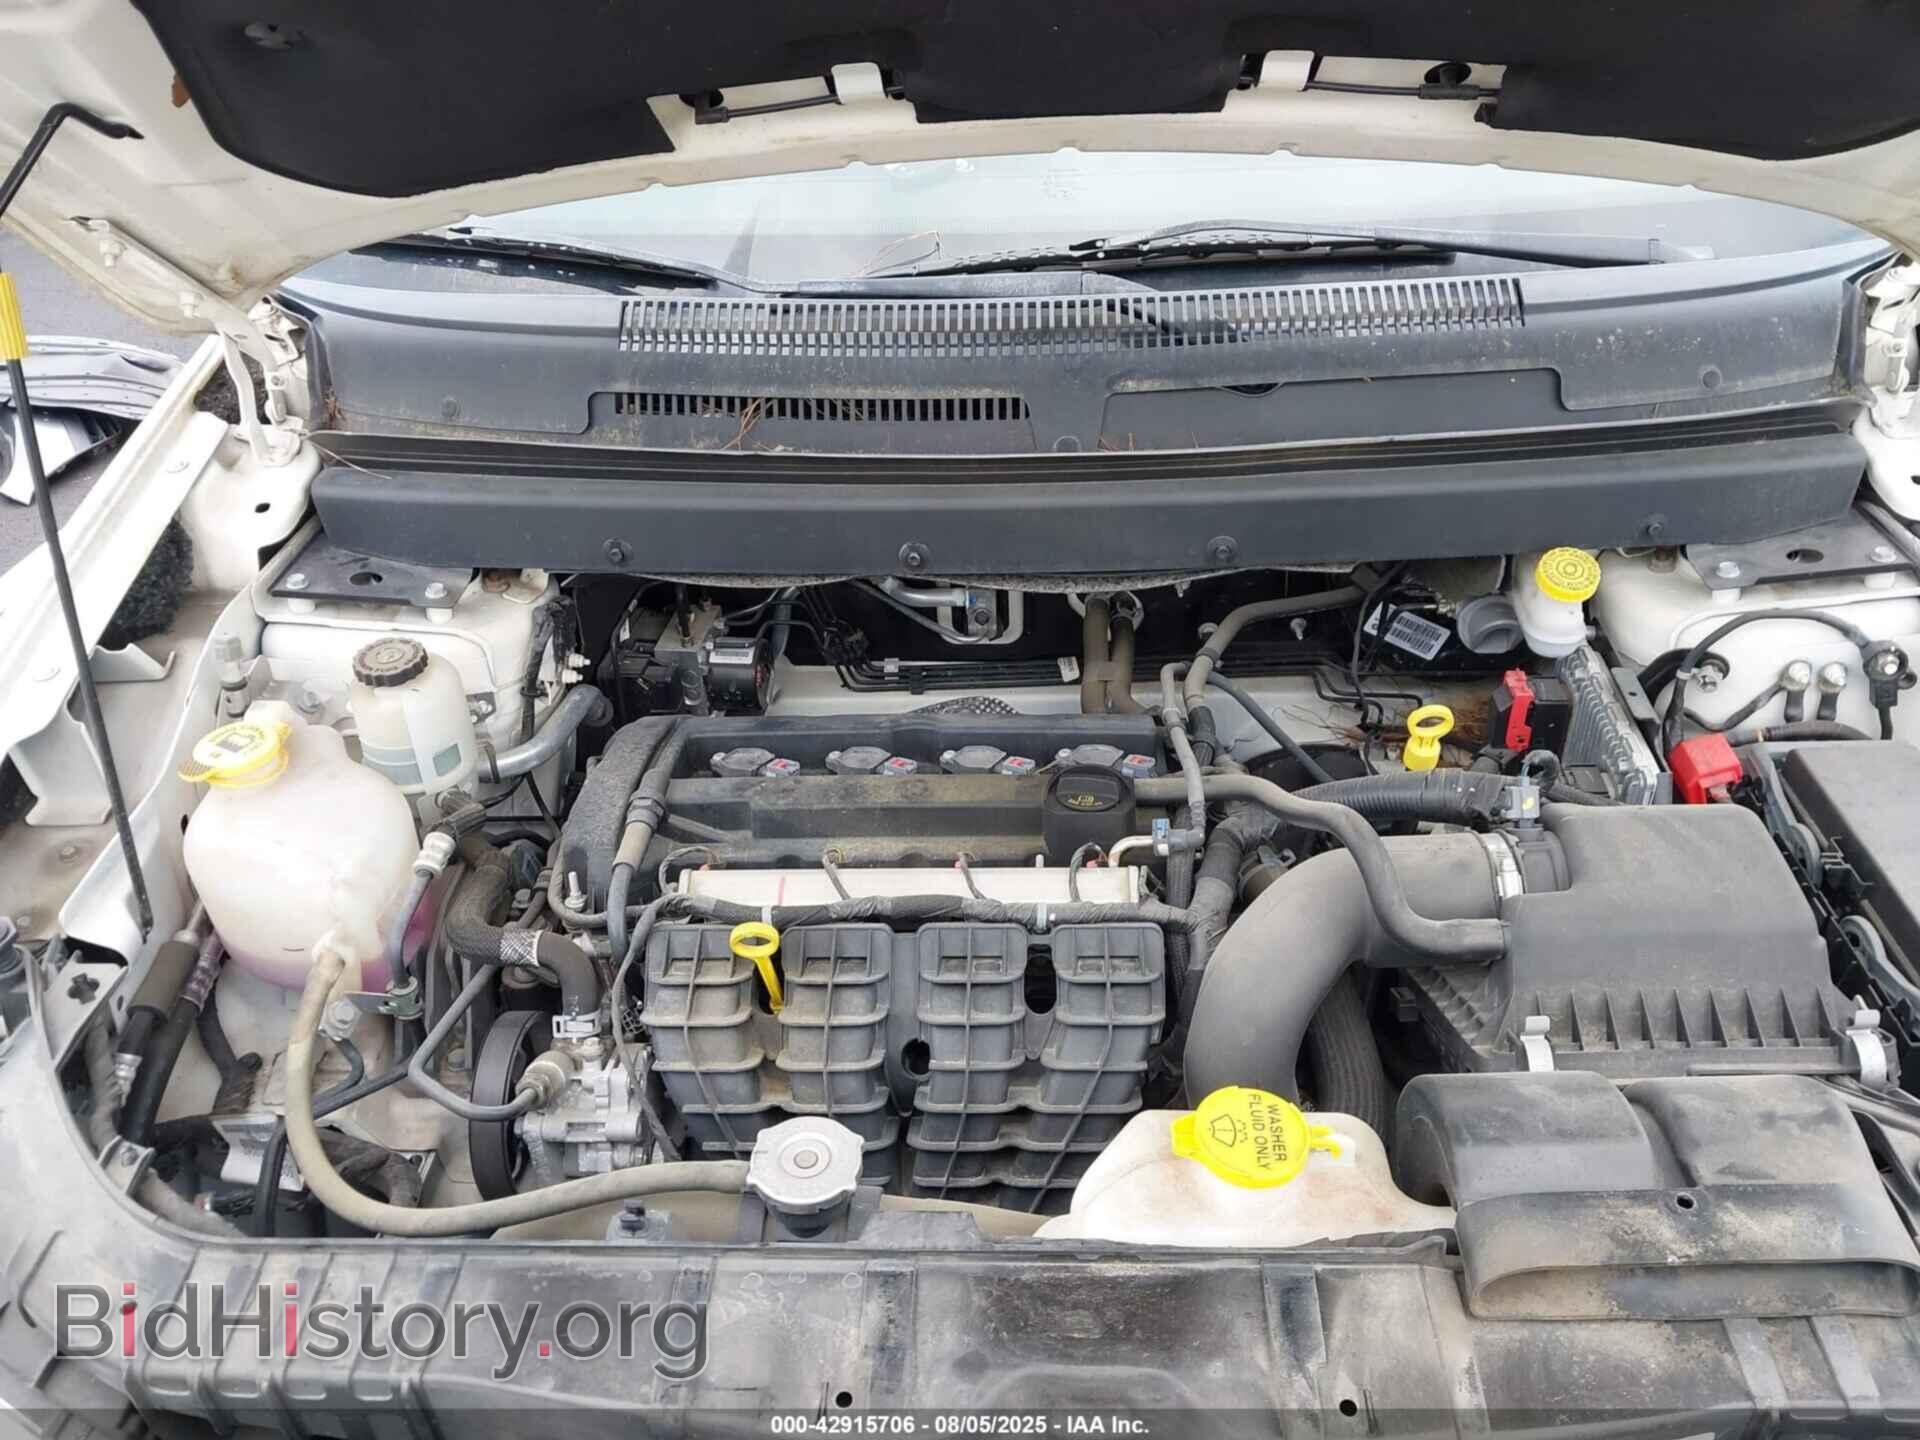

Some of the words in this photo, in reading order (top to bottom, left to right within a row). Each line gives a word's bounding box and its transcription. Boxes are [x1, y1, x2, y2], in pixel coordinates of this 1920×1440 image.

[1248, 1094, 1265, 1131] FLUID
[1267, 1104, 1288, 1161] WASHER
[1254, 1136, 1272, 1170] ONLY
